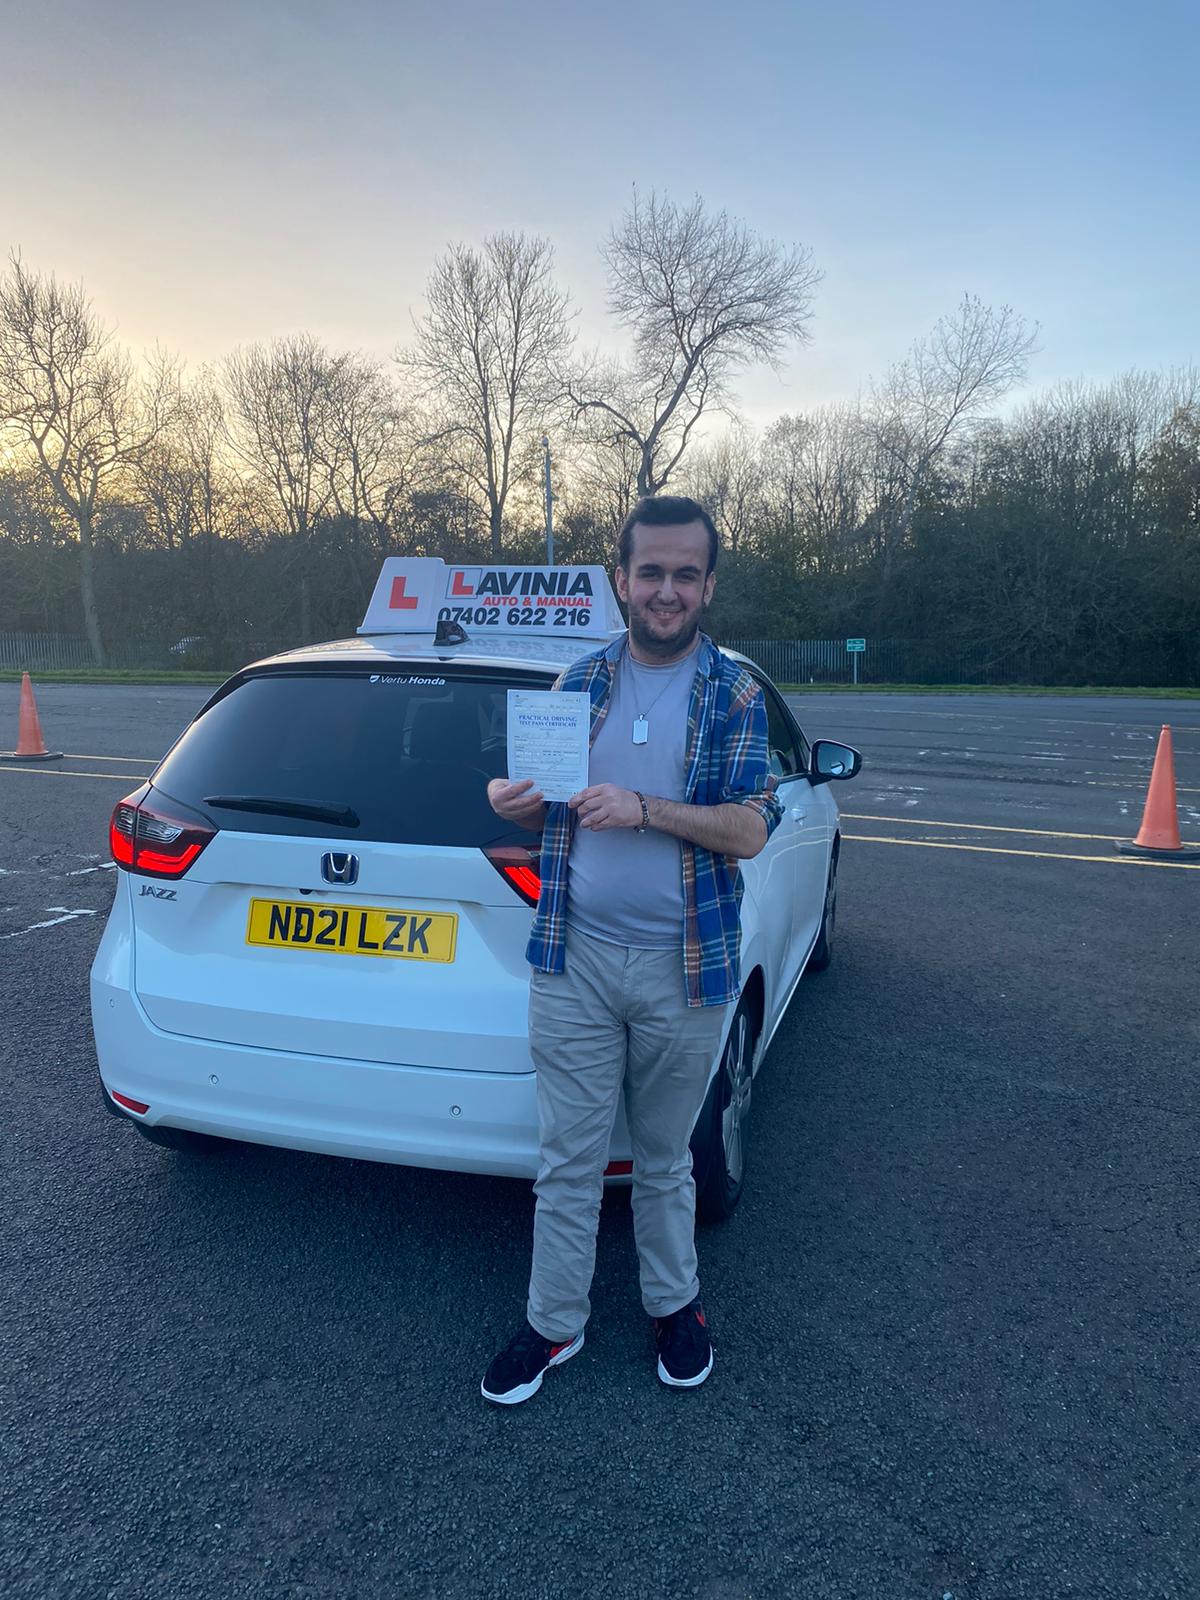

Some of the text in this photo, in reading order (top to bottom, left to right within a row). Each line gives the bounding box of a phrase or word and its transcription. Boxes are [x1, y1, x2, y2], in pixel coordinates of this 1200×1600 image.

[389, 576, 418, 609] L
[452, 571, 593, 597] LAVINIA
[482, 597, 592, 607] AUTO & MANUAL
[438, 607, 591, 626] 07402 622 216
[381, 675, 446, 686] Vertu Honda
[138, 884, 177, 901] JAZZ
[268, 904, 433, 954] ND21 LZK
